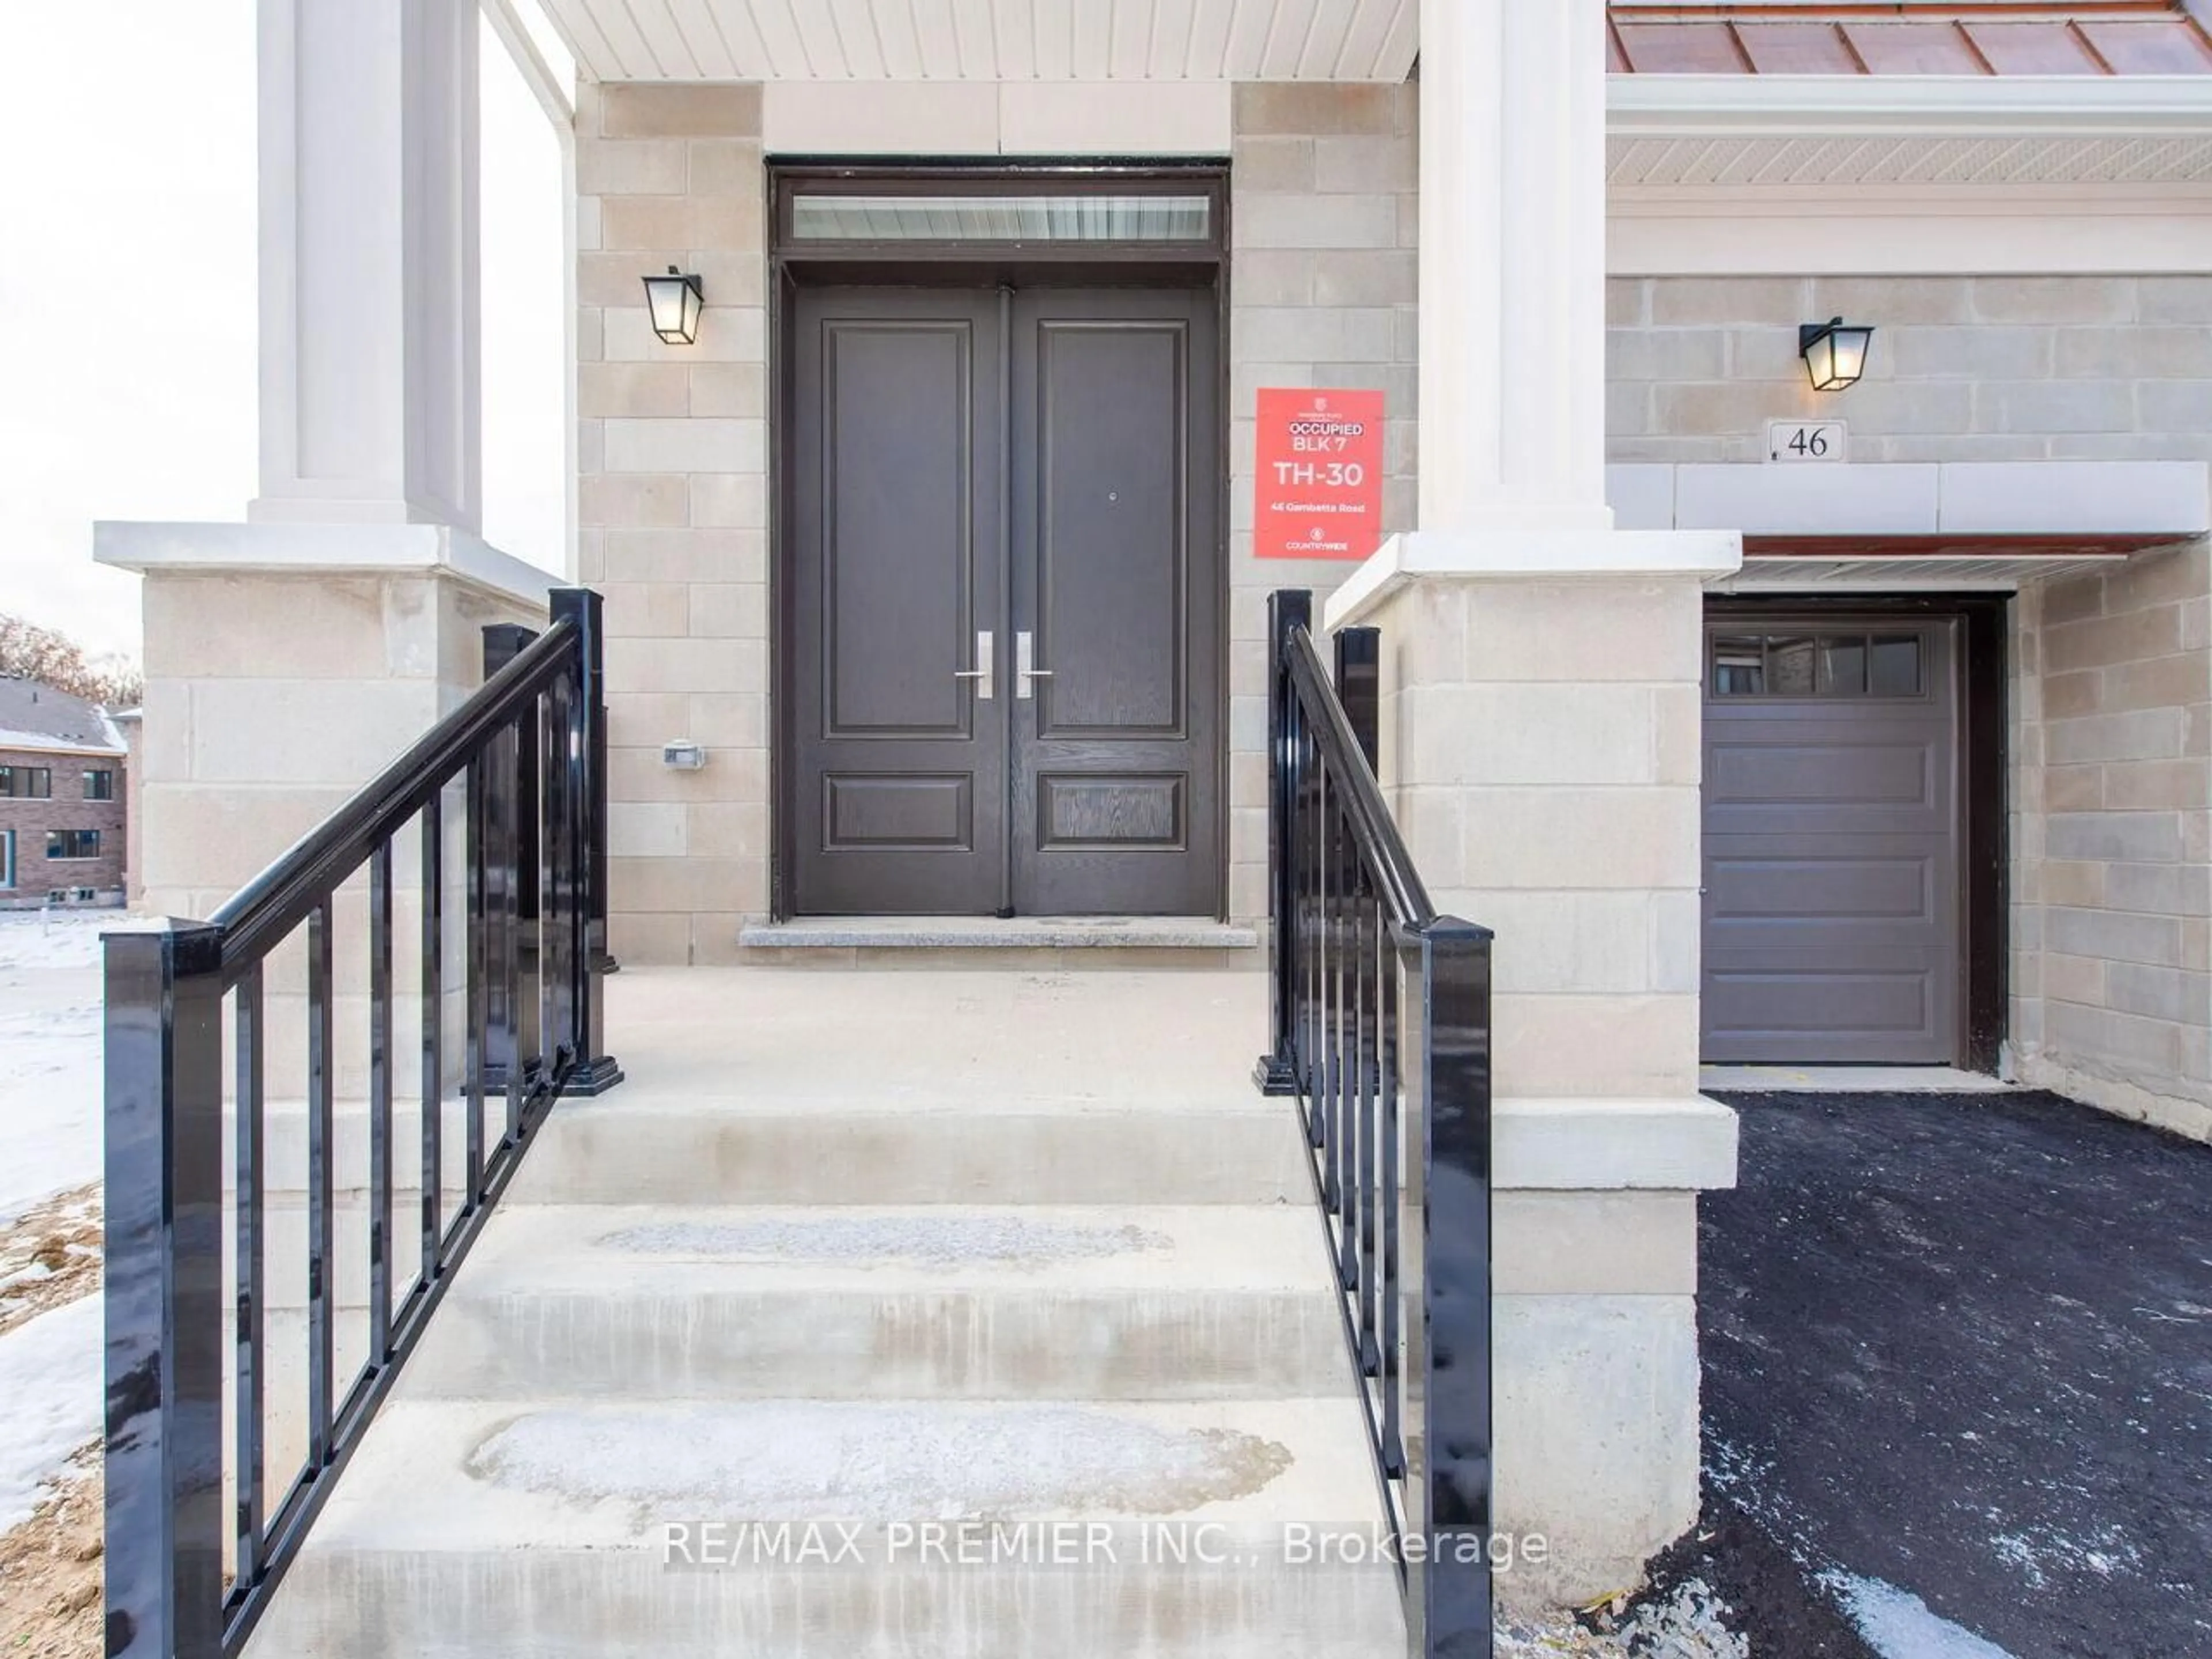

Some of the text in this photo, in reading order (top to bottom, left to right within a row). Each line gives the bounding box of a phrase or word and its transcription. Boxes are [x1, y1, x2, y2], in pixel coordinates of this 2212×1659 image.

[1289, 423, 1363, 435] OCCUPIED
[1293, 437, 1347, 452] BLK 7
[1788, 427, 1827, 456] 46
[1273, 461, 1363, 486] TH-30
[1339, 504, 1365, 513] Road
